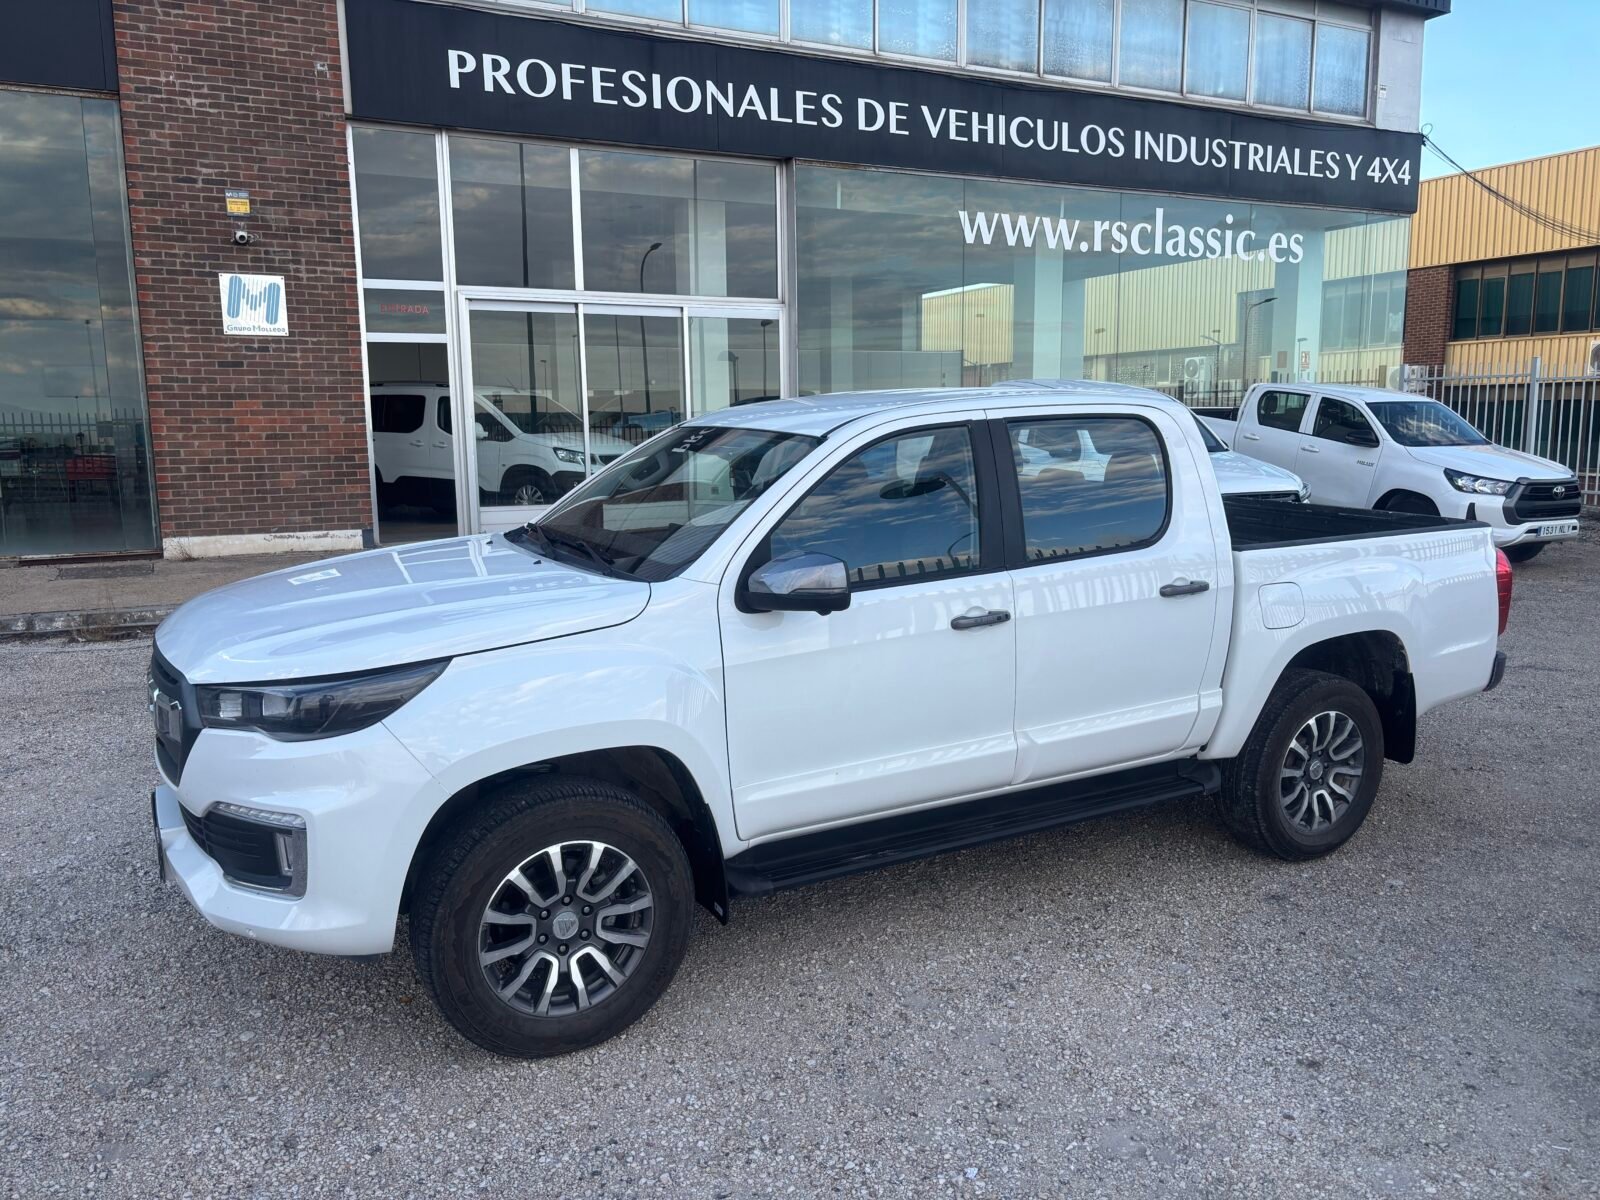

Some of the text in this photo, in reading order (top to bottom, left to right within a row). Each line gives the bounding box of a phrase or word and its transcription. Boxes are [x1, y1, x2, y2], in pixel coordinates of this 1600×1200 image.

[447, 49, 1412, 186] PROFESIONALES DE VEHICULOS INDUSTRIALES Y 4X4
[958, 207, 1305, 264] www.rsclassic.es
